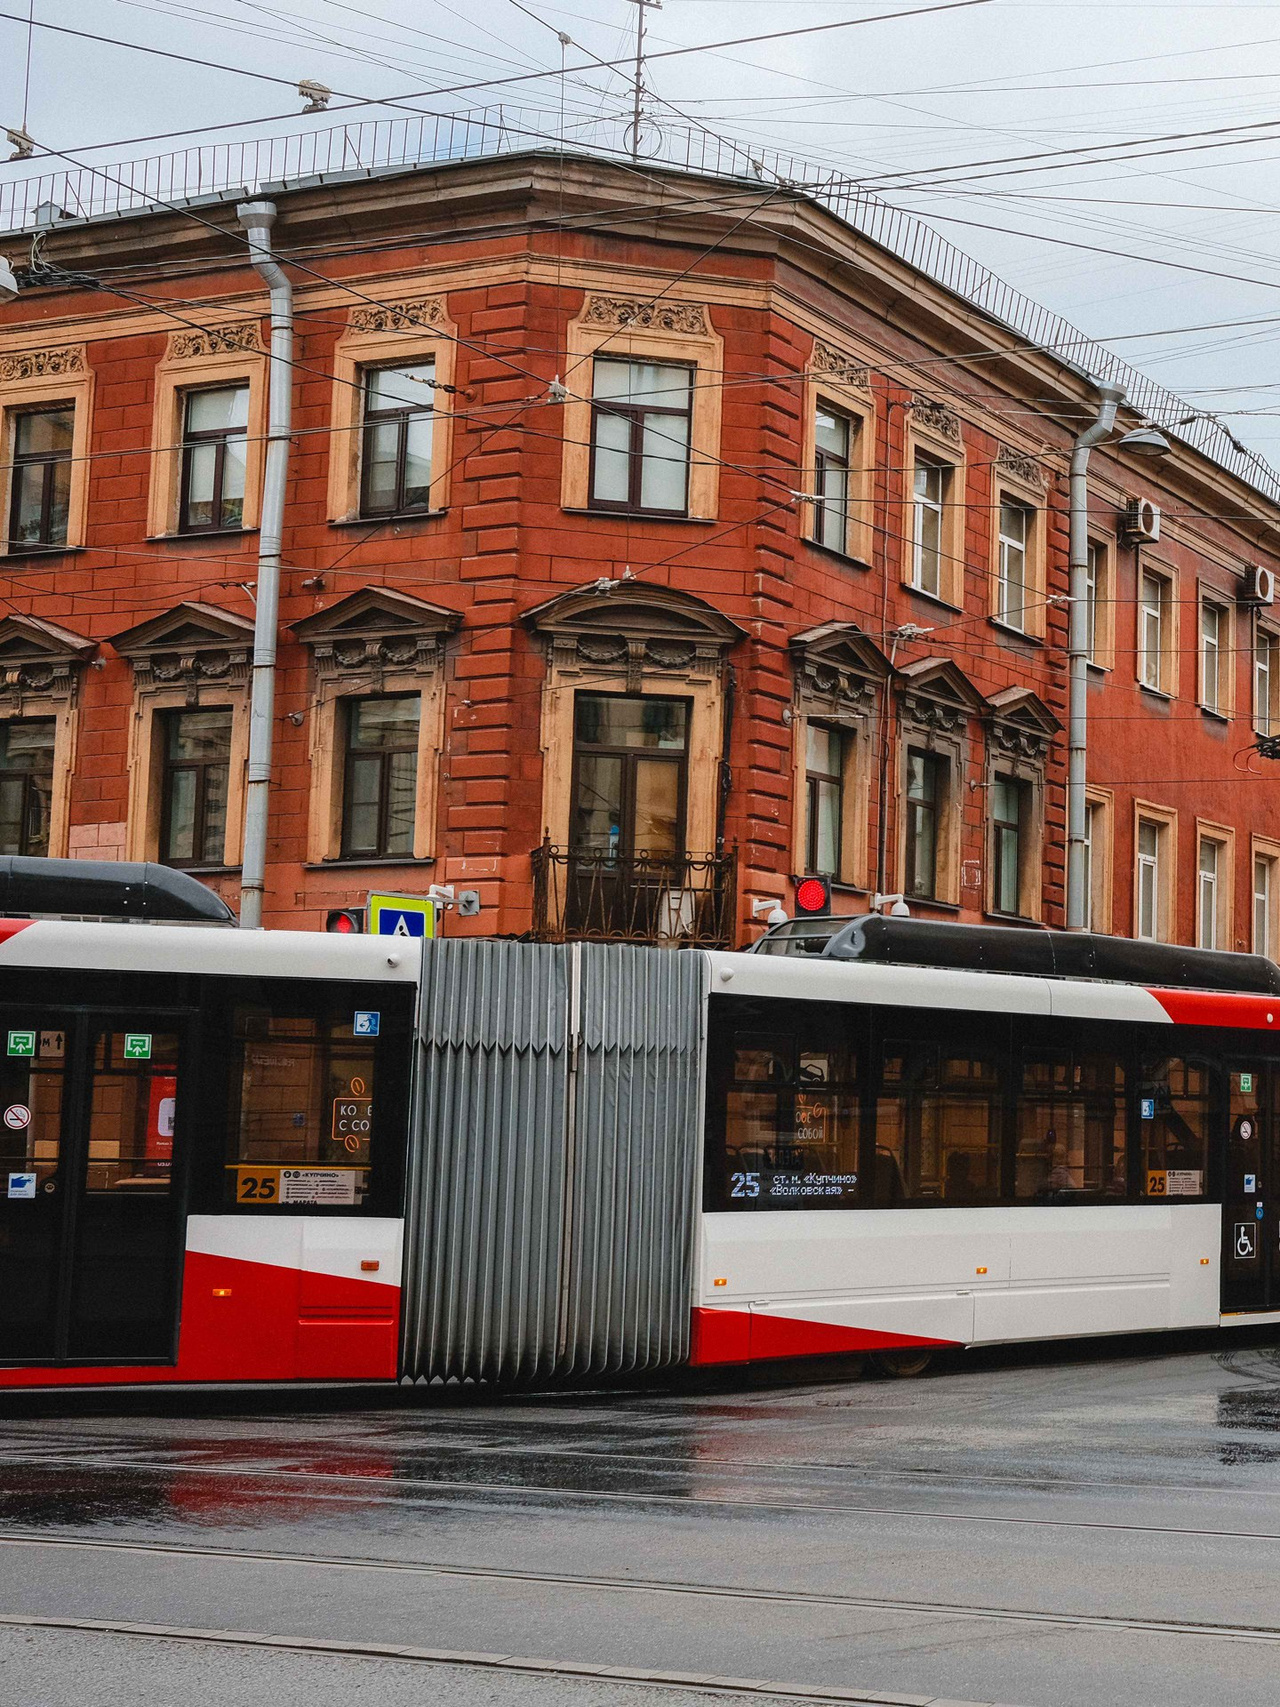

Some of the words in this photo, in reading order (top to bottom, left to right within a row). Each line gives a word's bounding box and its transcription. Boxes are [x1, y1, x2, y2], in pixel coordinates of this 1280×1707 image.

[730, 1172, 760, 1198] 25
[772, 1175, 789, 1184] ст.
[803, 1172, 858, 1185] «Купчино»
[1149, 1176, 1165, 1193] 25
[241, 1177, 276, 1199] 25
[769, 1184, 843, 1196] «Волковская»
